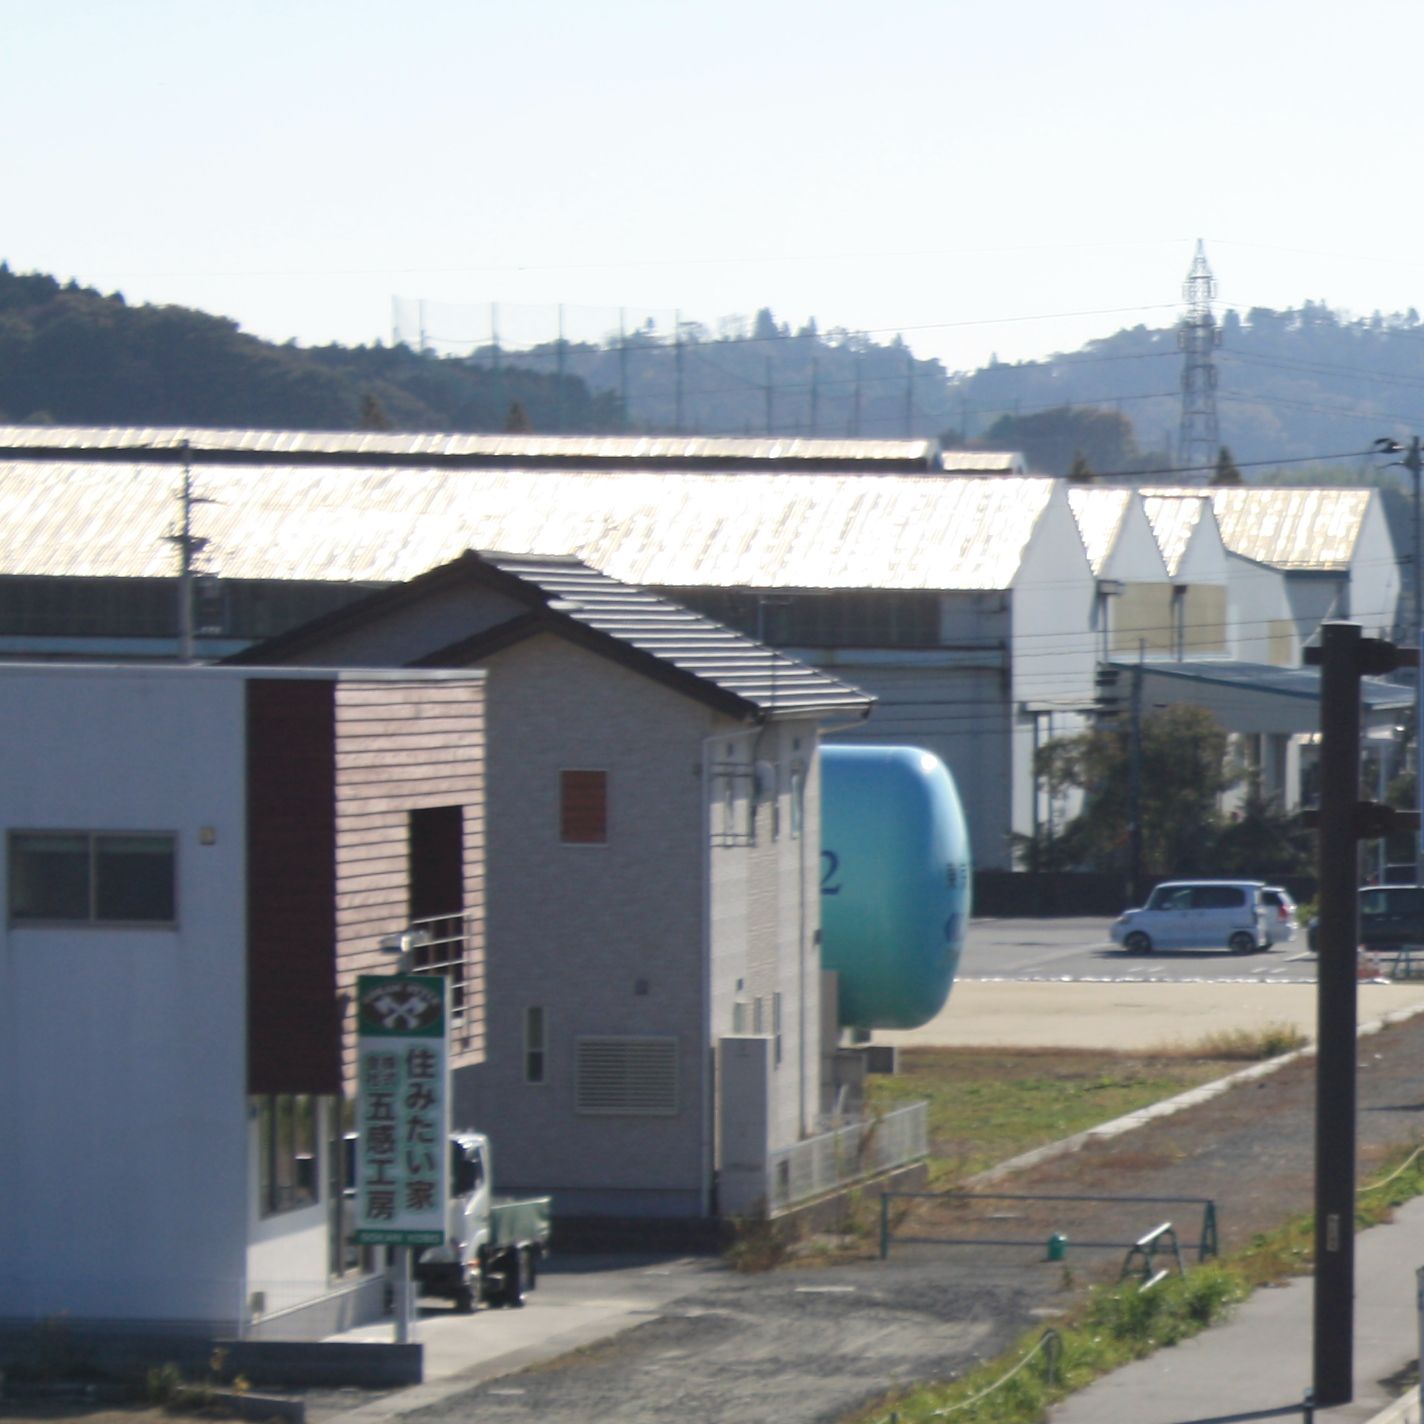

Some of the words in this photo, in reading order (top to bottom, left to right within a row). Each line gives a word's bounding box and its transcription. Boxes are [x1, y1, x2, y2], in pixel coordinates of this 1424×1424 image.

[404, 1047, 436, 1214] 住みたい家
